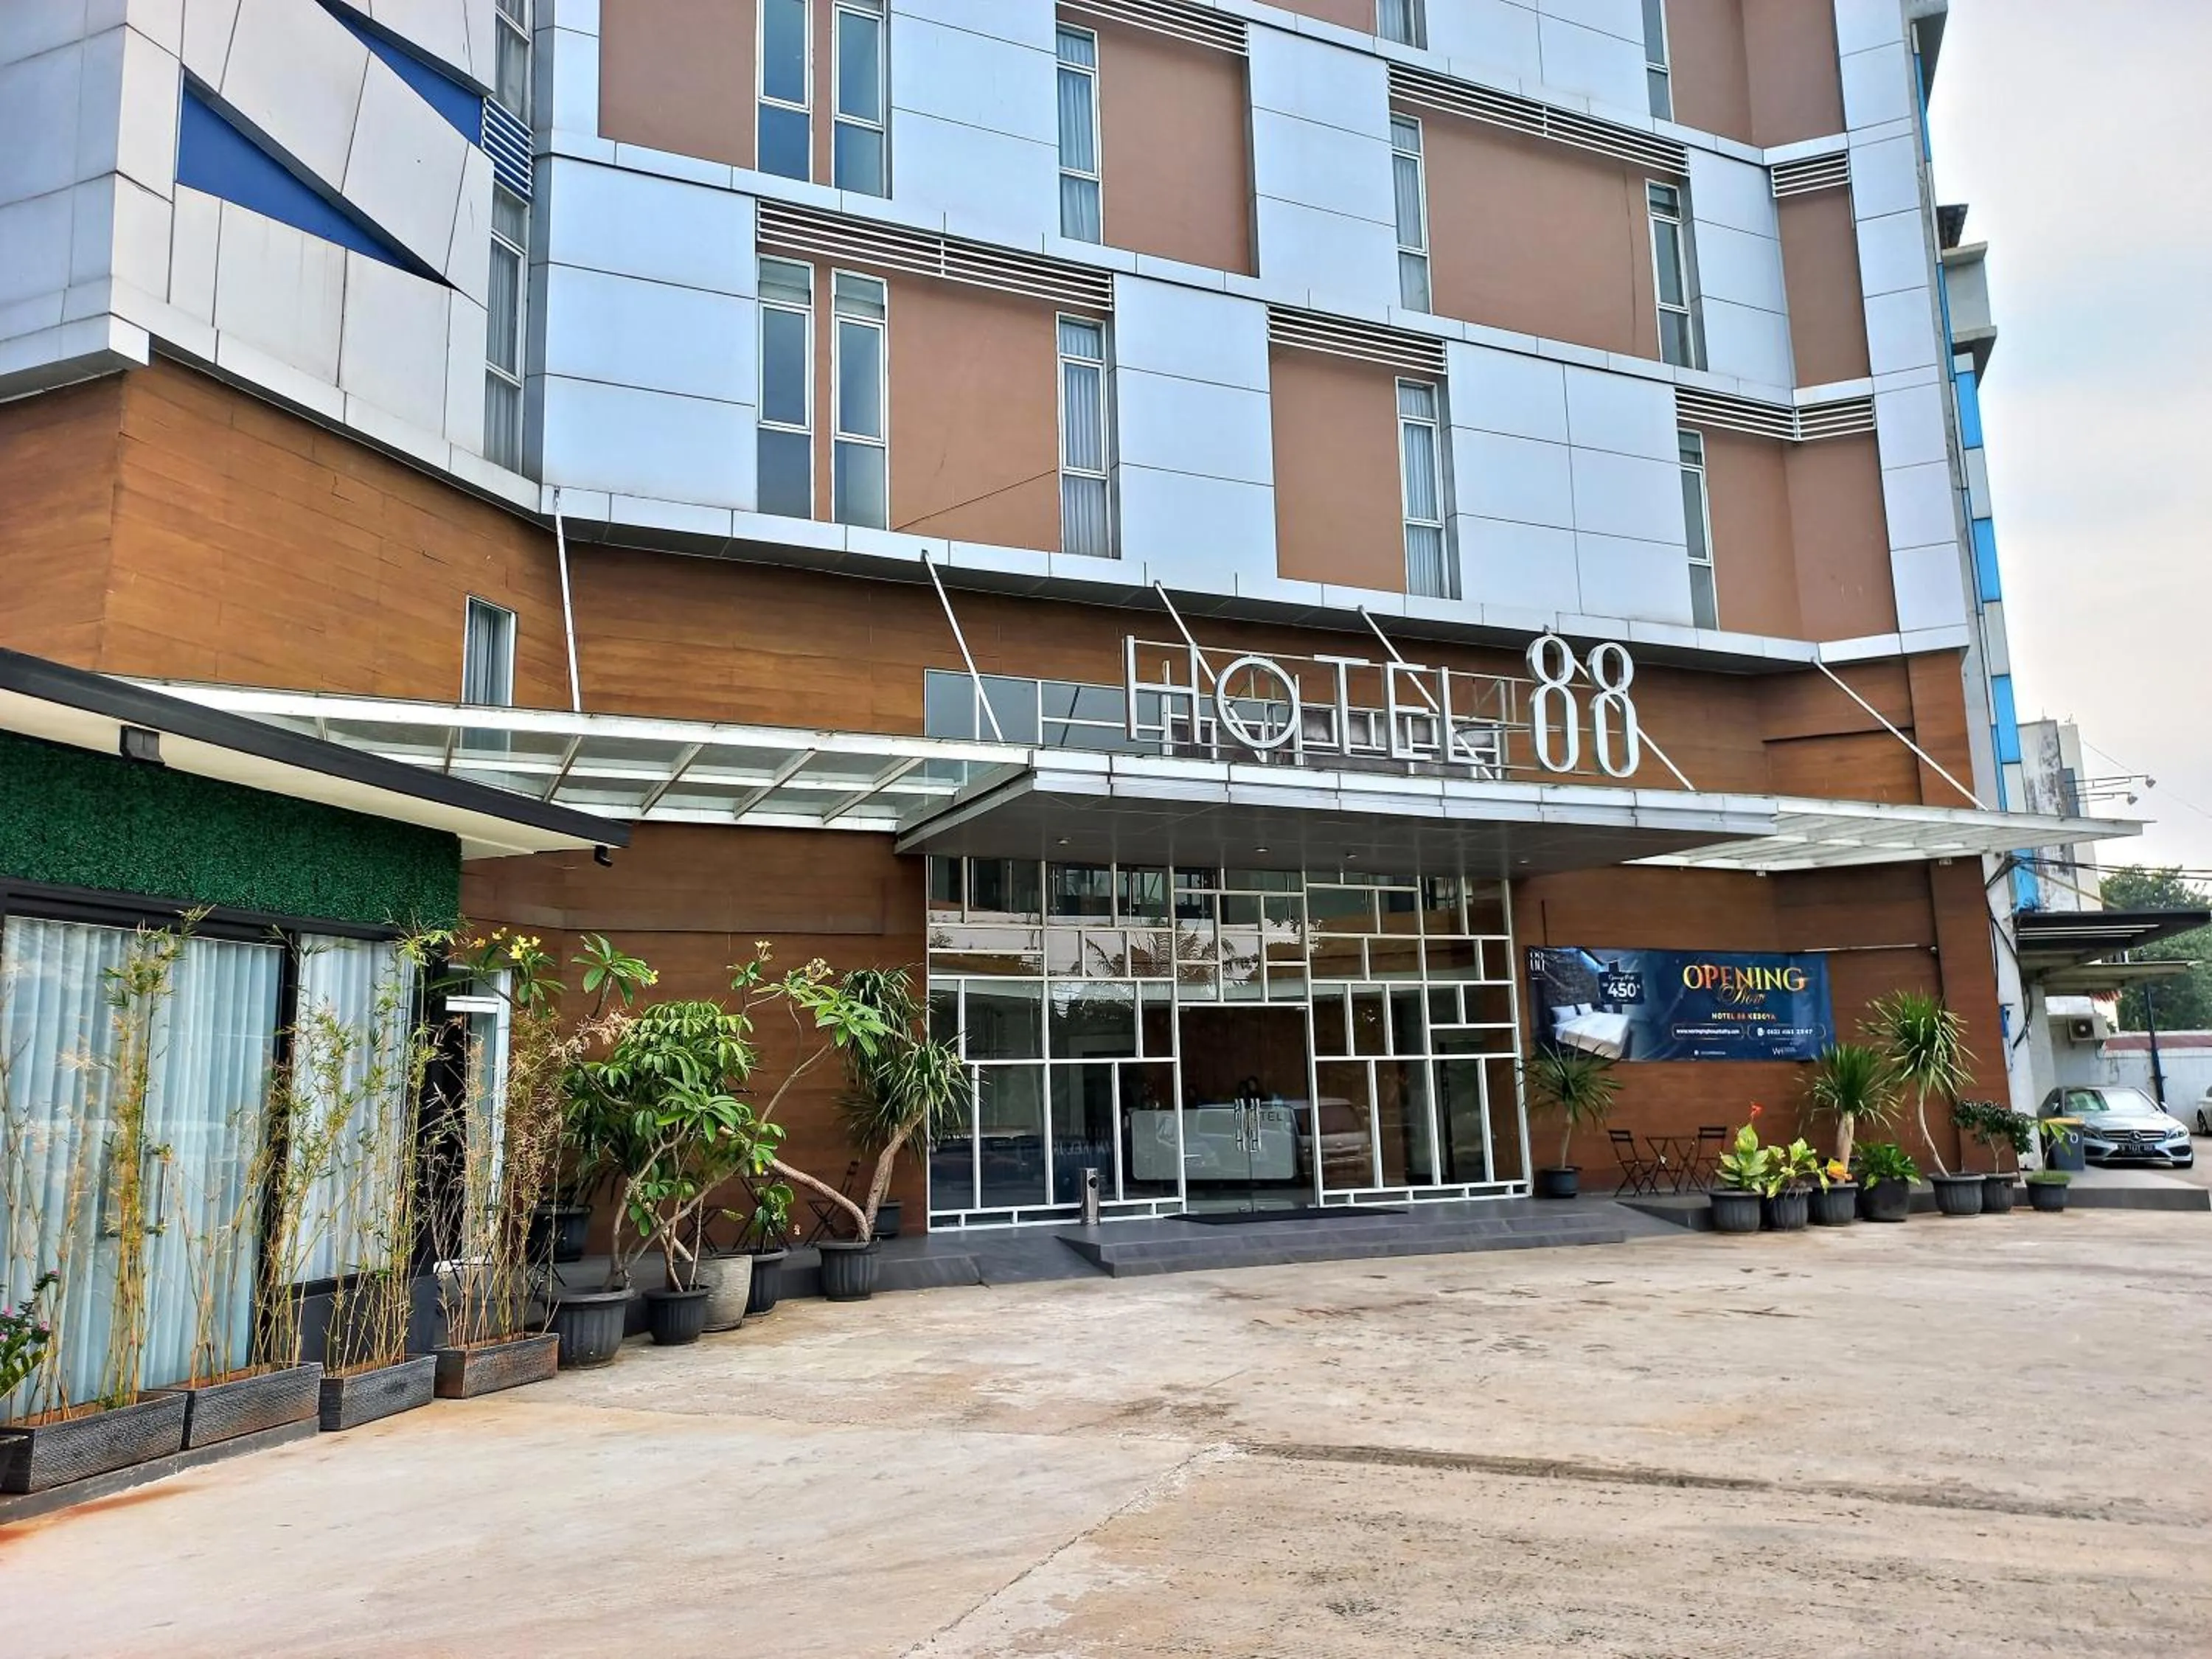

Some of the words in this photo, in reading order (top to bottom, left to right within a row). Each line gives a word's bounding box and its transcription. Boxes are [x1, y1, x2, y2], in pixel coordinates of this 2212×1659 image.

[1123, 635, 1484, 765] HOTEL
[1526, 635, 1640, 778] 88
[1683, 964, 1806, 992] OPENING
[1711, 1012, 1735, 1020] HOTEL
